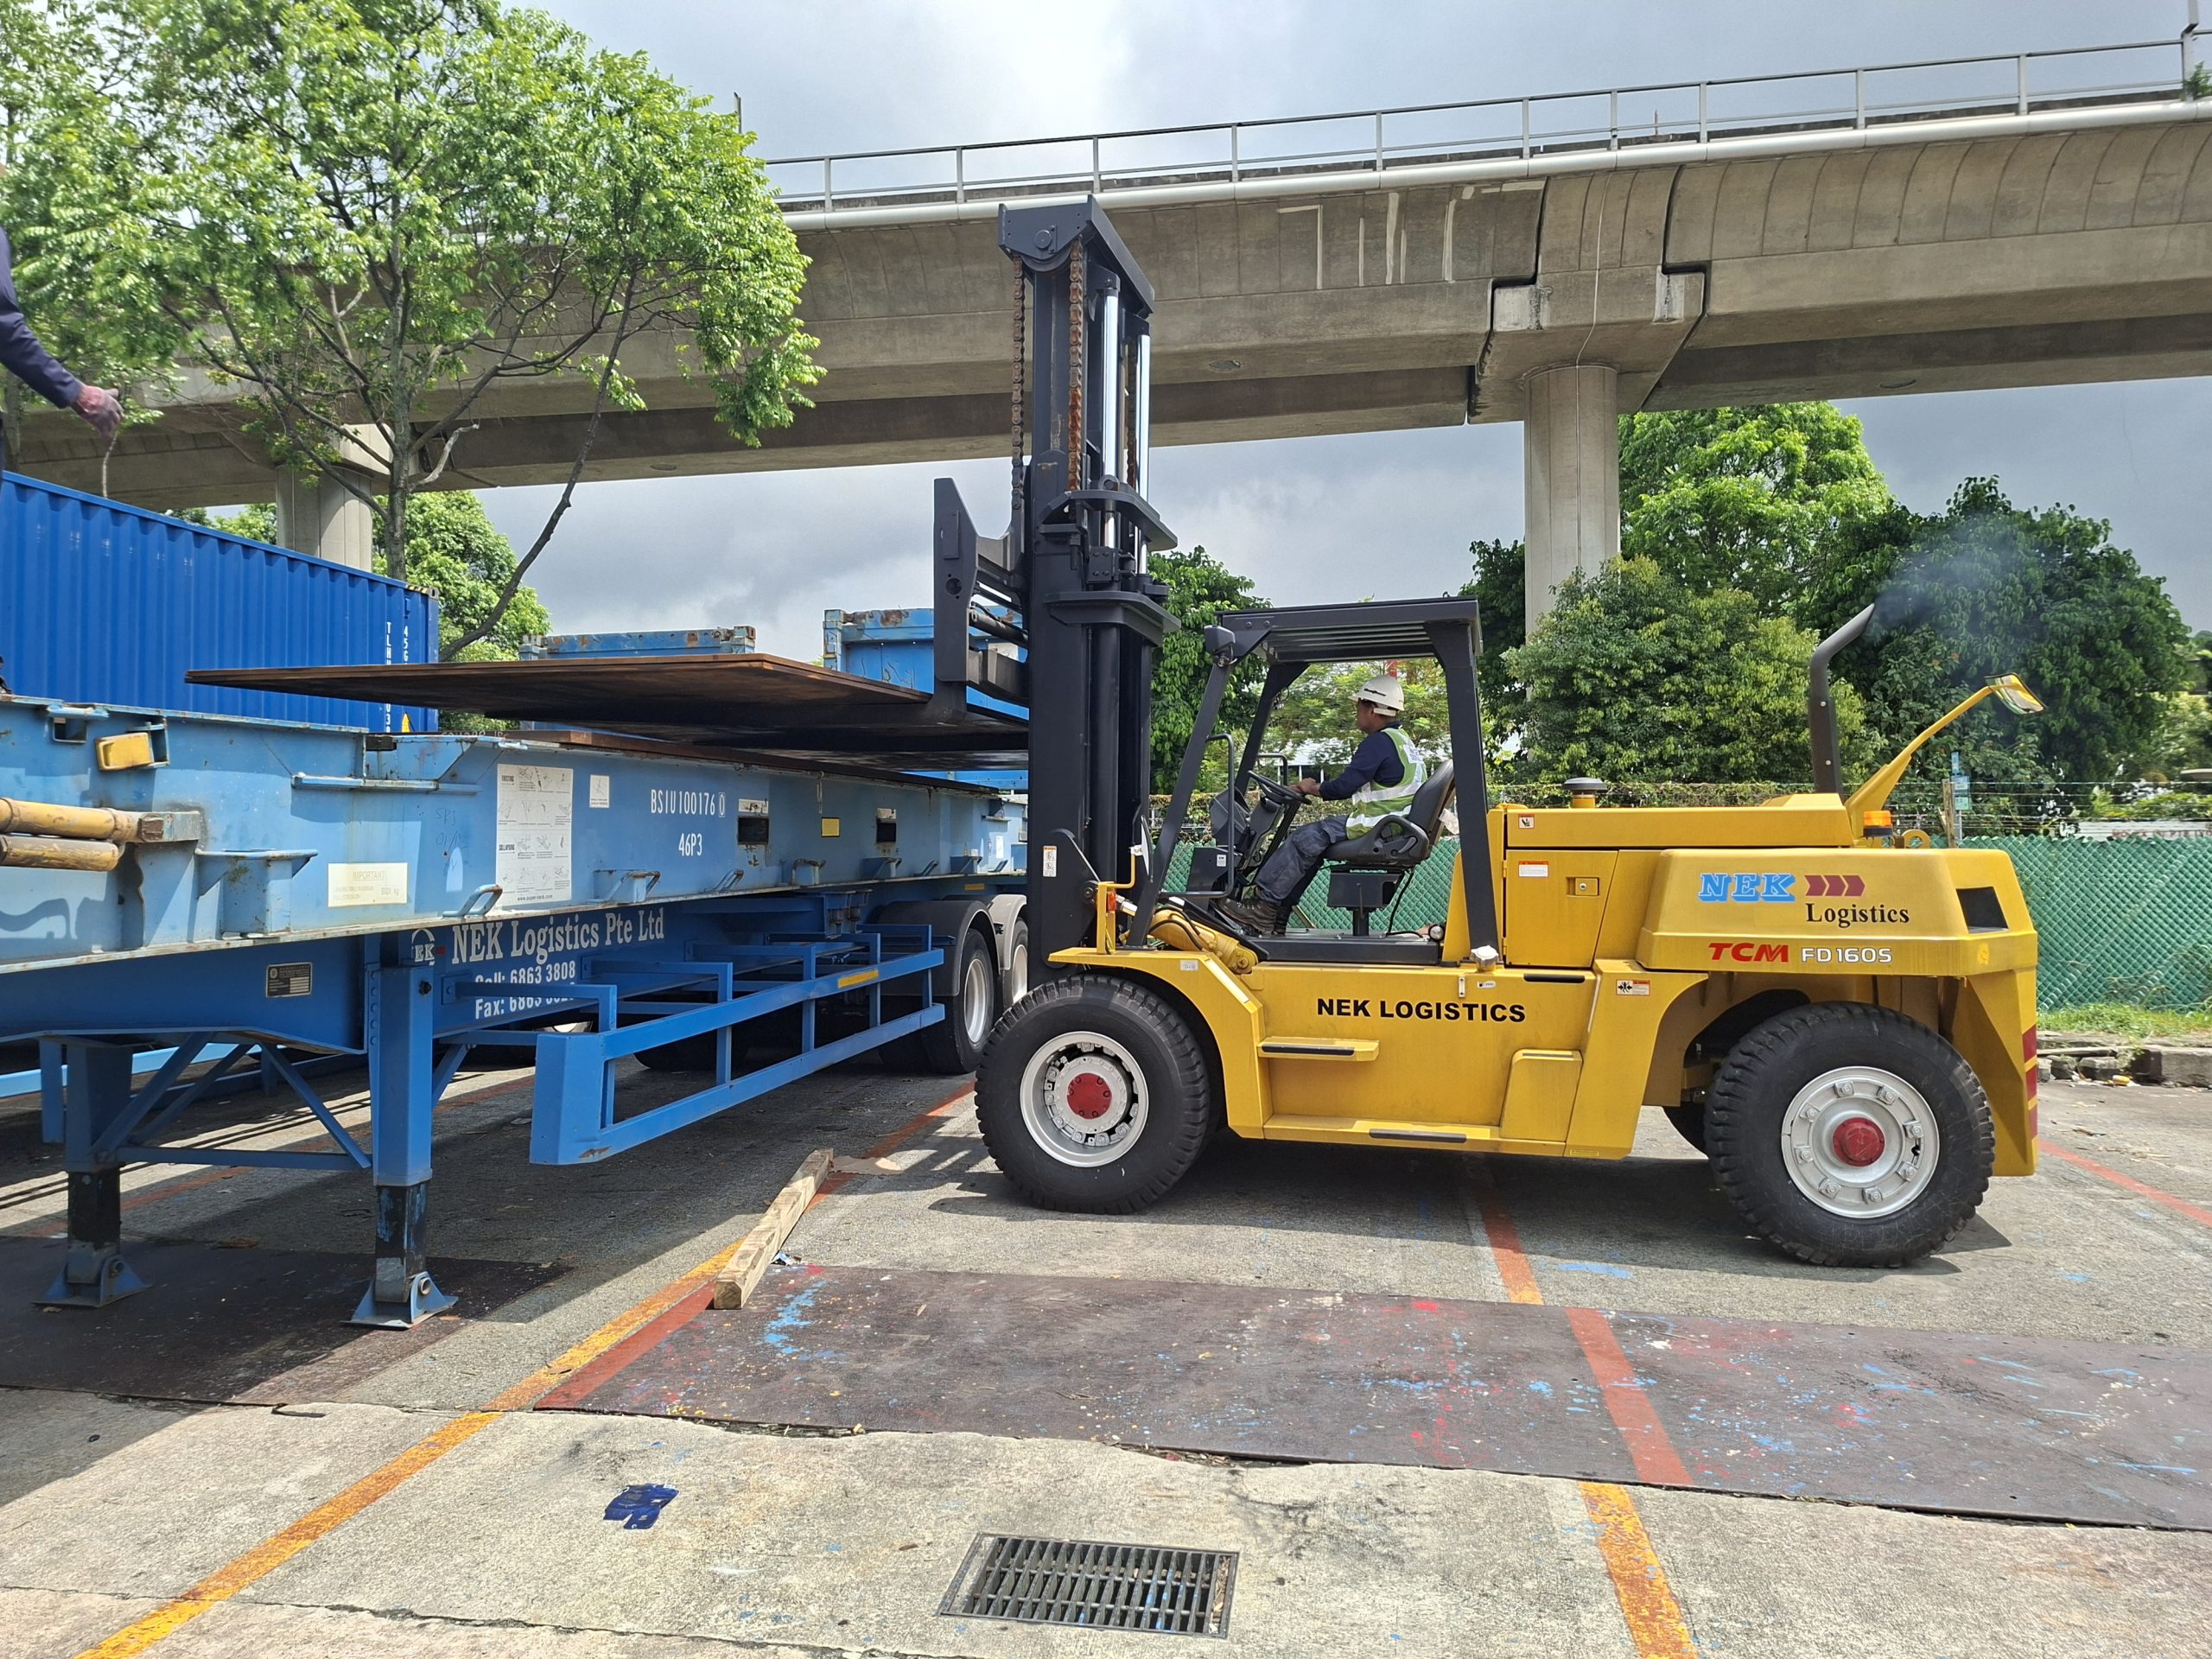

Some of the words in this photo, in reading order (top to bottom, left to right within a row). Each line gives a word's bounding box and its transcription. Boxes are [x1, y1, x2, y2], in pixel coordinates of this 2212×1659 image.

[651, 789, 715, 816] BSIU100176
[678, 832, 702, 856] 46P3
[1697, 873, 1796, 902] NEK
[1805, 903, 1910, 928] Logistics
[452, 922, 504, 964] NEK
[511, 914, 599, 964] Logistics
[605, 912, 632, 946] Pte
[638, 907, 664, 941] Ltd
[414, 943, 435, 962] EK
[1708, 943, 1789, 963] TCM
[511, 966, 542, 983] 6863
[545, 960, 575, 982] 3808
[475, 998, 504, 1020] Fax:
[1317, 998, 1370, 1017] NEK
[1380, 1001, 1526, 1023] LOGISTICS
